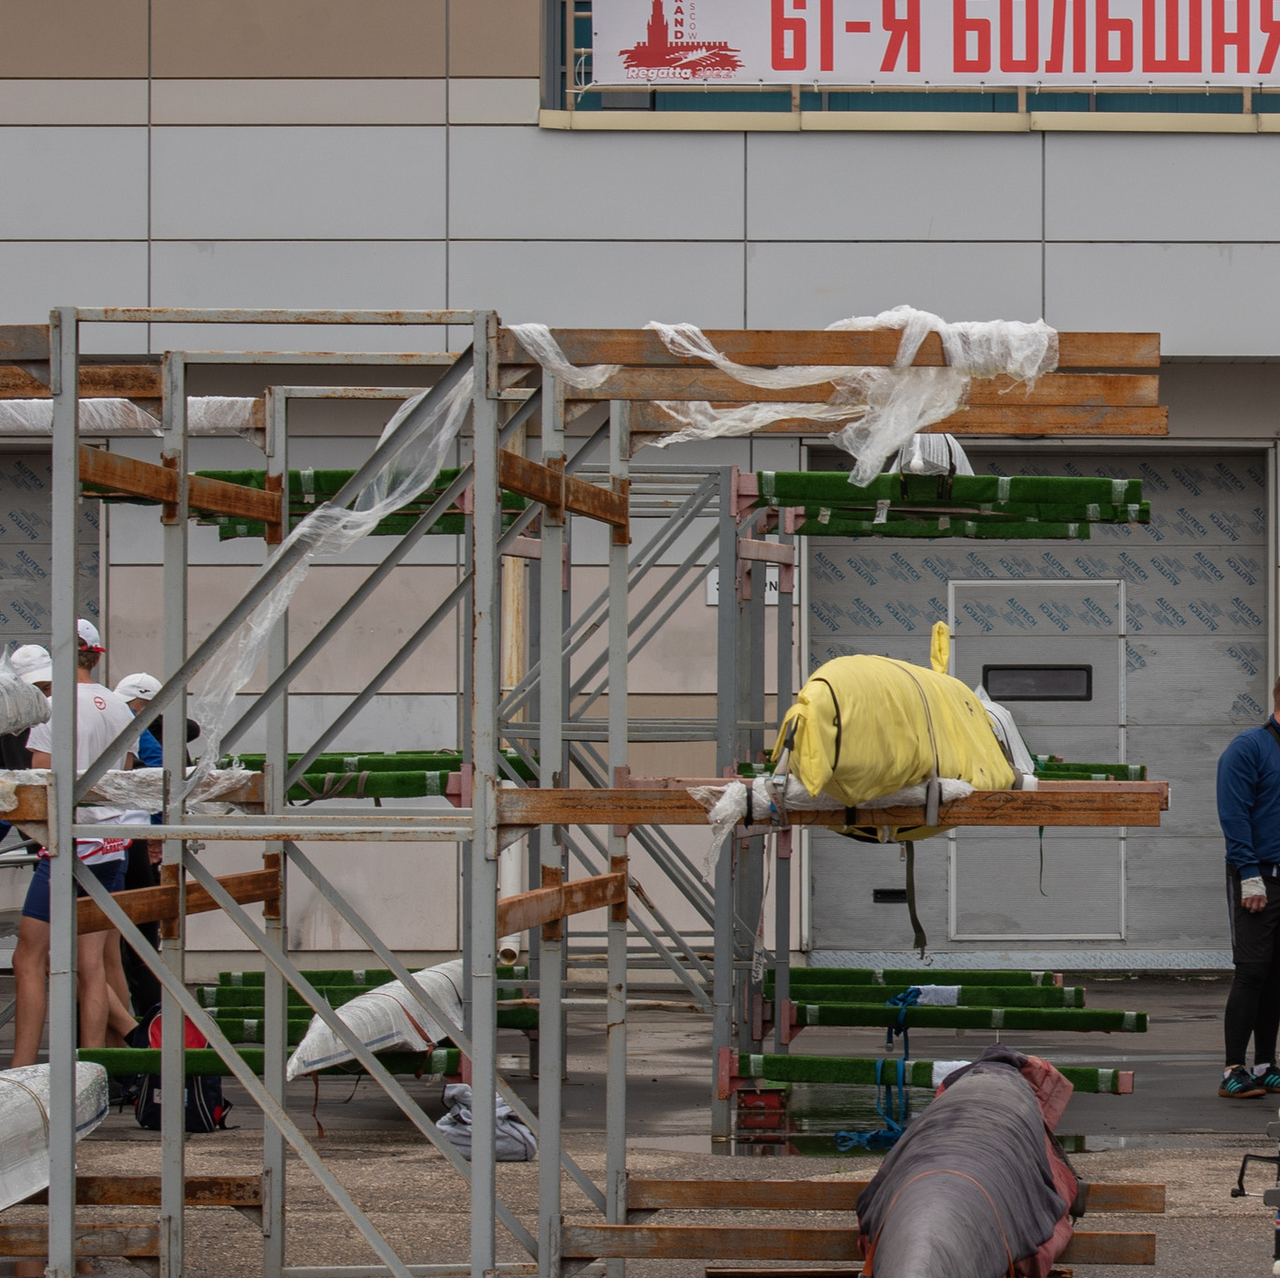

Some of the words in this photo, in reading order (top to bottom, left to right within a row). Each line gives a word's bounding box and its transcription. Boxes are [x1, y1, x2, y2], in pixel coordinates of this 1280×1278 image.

[627, 67, 692, 81] Regatta
[695, 67, 733, 79] 2022
[15, 460, 45, 490] ALUTECH
[1139, 462, 1170, 492] ALUTECH
[1172, 468, 1201, 497] ALUTECH
[1215, 462, 1246, 492] ALUTECH
[8, 511, 38, 541] ALUTECH
[1177, 507, 1208, 537] ALUTECH
[1209, 513, 1240, 542] ALUTECH
[17, 550, 48, 579] ALUTECH
[815, 552, 846, 581] ALUTECH
[846, 558, 876, 586] ALUTECH
[892, 552, 922, 581] ALUTECH
[922, 558, 948, 586] LUTECH
[1119, 552, 1149, 580] ALUTECH
[1150, 558, 1180, 586] ALUTECH
[1195, 552, 1225, 580] ALUTECH
[1226, 558, 1256, 586] ALUTECH
[10, 601, 42, 631] ALUTECH
[810, 603, 838, 631] ALUTECH
[854, 598, 883, 626] ALUTECH
[885, 603, 914, 631] ALUTECH
[963, 604, 993, 632] ALUTECH
[1008, 598, 1038, 626] ALUTECH
[1039, 603, 1069, 631] ALUTECH
[1083, 598, 1113, 626] ALUTECH
[1157, 598, 1187, 626] ALUTECH
[1188, 603, 1218, 631] ALUTECH
[1232, 597, 1263, 626] ALUTECH
